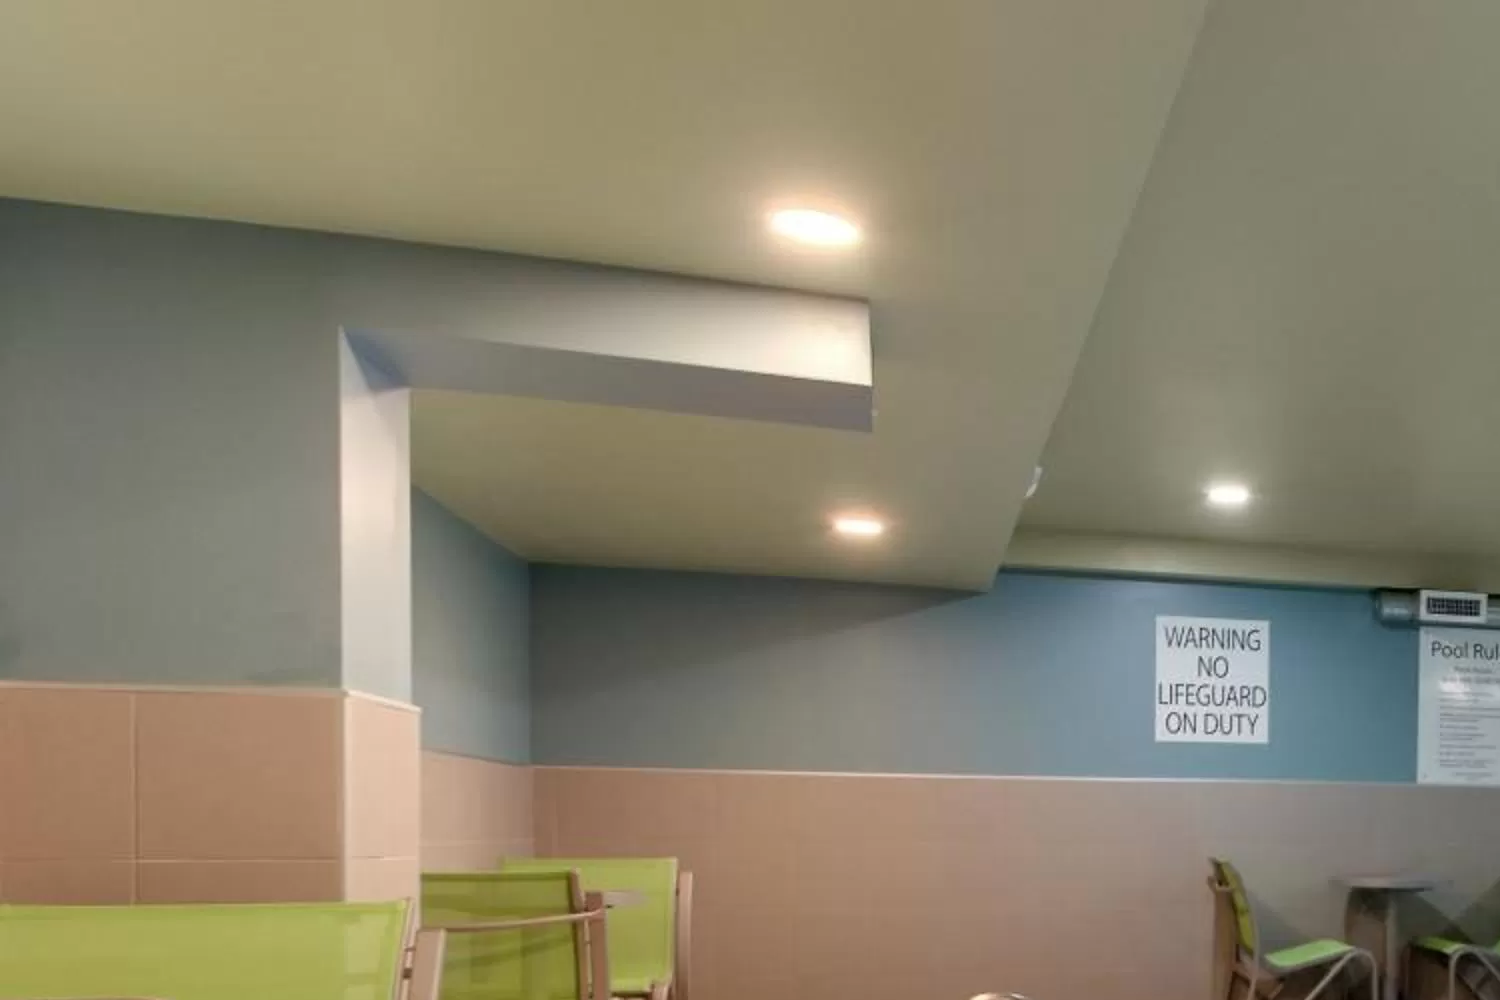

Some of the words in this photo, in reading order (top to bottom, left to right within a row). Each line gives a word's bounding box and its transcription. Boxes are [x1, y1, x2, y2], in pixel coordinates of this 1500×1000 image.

[1164, 625, 1262, 652] WARNING
[1430, 640, 1469, 659] Pool
[1197, 655, 1229, 678] NO
[1158, 681, 1267, 708] LIFEGUARD
[1165, 711, 1197, 734] ON
[1203, 713, 1260, 736] DUTY
